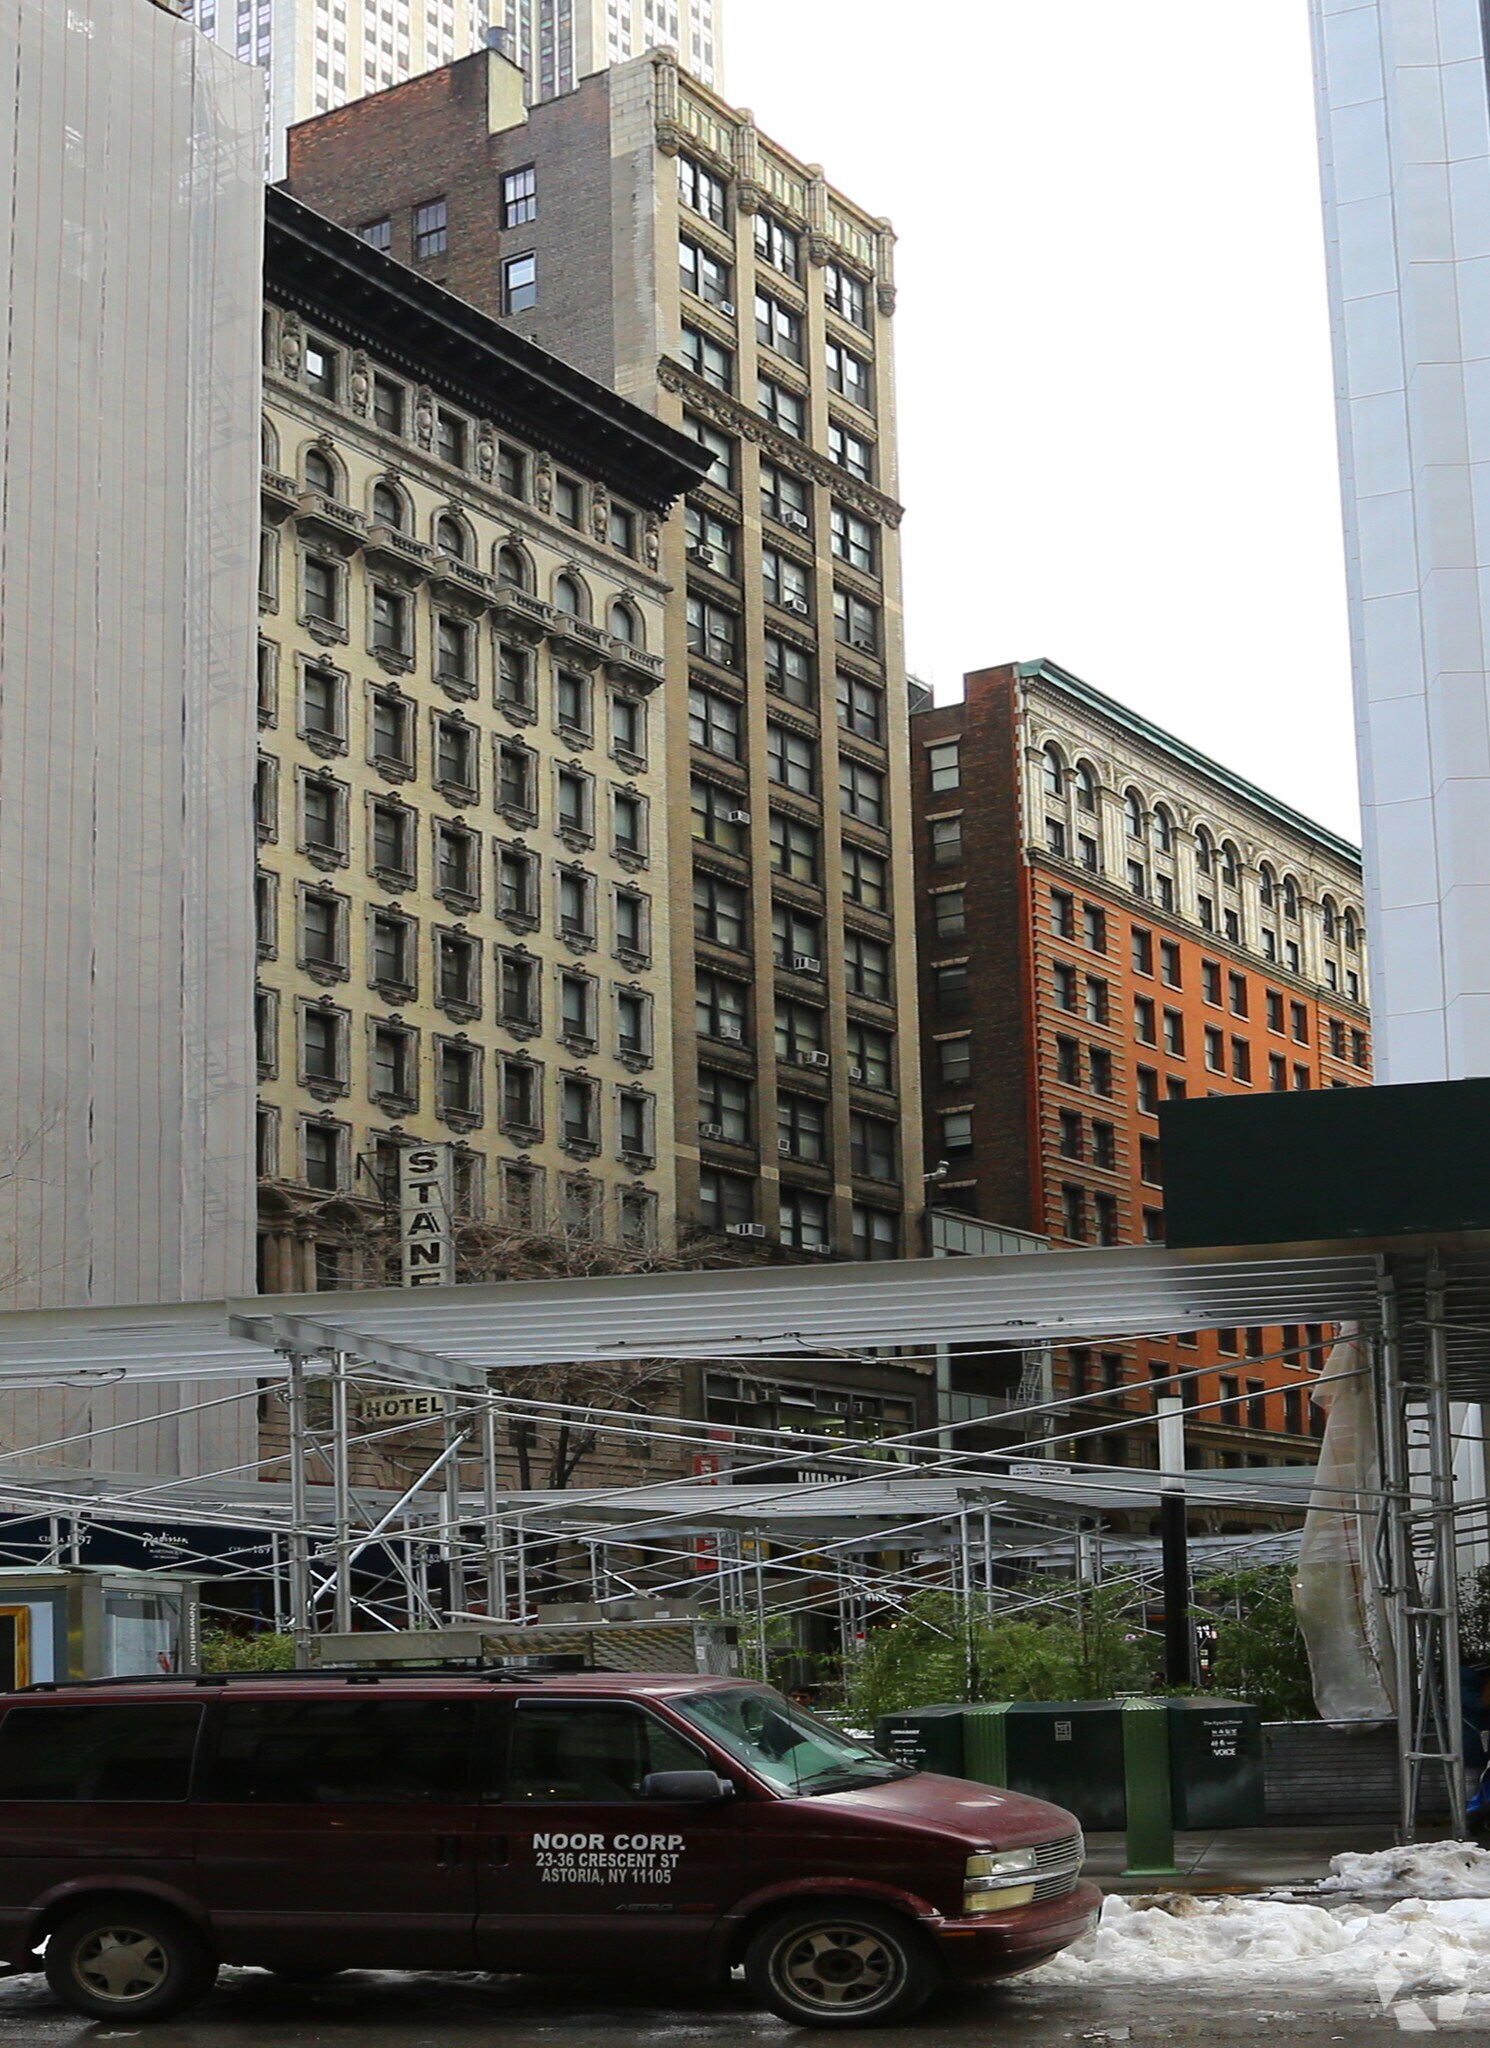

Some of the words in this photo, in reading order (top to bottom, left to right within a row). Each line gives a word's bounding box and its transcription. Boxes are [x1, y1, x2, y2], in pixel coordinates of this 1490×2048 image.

[366, 1397, 443, 1418] HOTEL
[188, 1602, 197, 1666] Newsstand
[1213, 1748, 1237, 1756] VOICE
[533, 1833, 605, 1850] NOOR
[613, 1834, 686, 1851] CORP.
[536, 1852, 574, 1867] 23-36
[578, 1853, 656, 1868] CRESCENT
[660, 1854, 679, 1868] ST
[541, 1868, 604, 1886] ASTORIA,
[608, 1869, 628, 1883] NY
[631, 1869, 672, 1884] 11105
[615, 1903, 674, 1911] ASTRO
